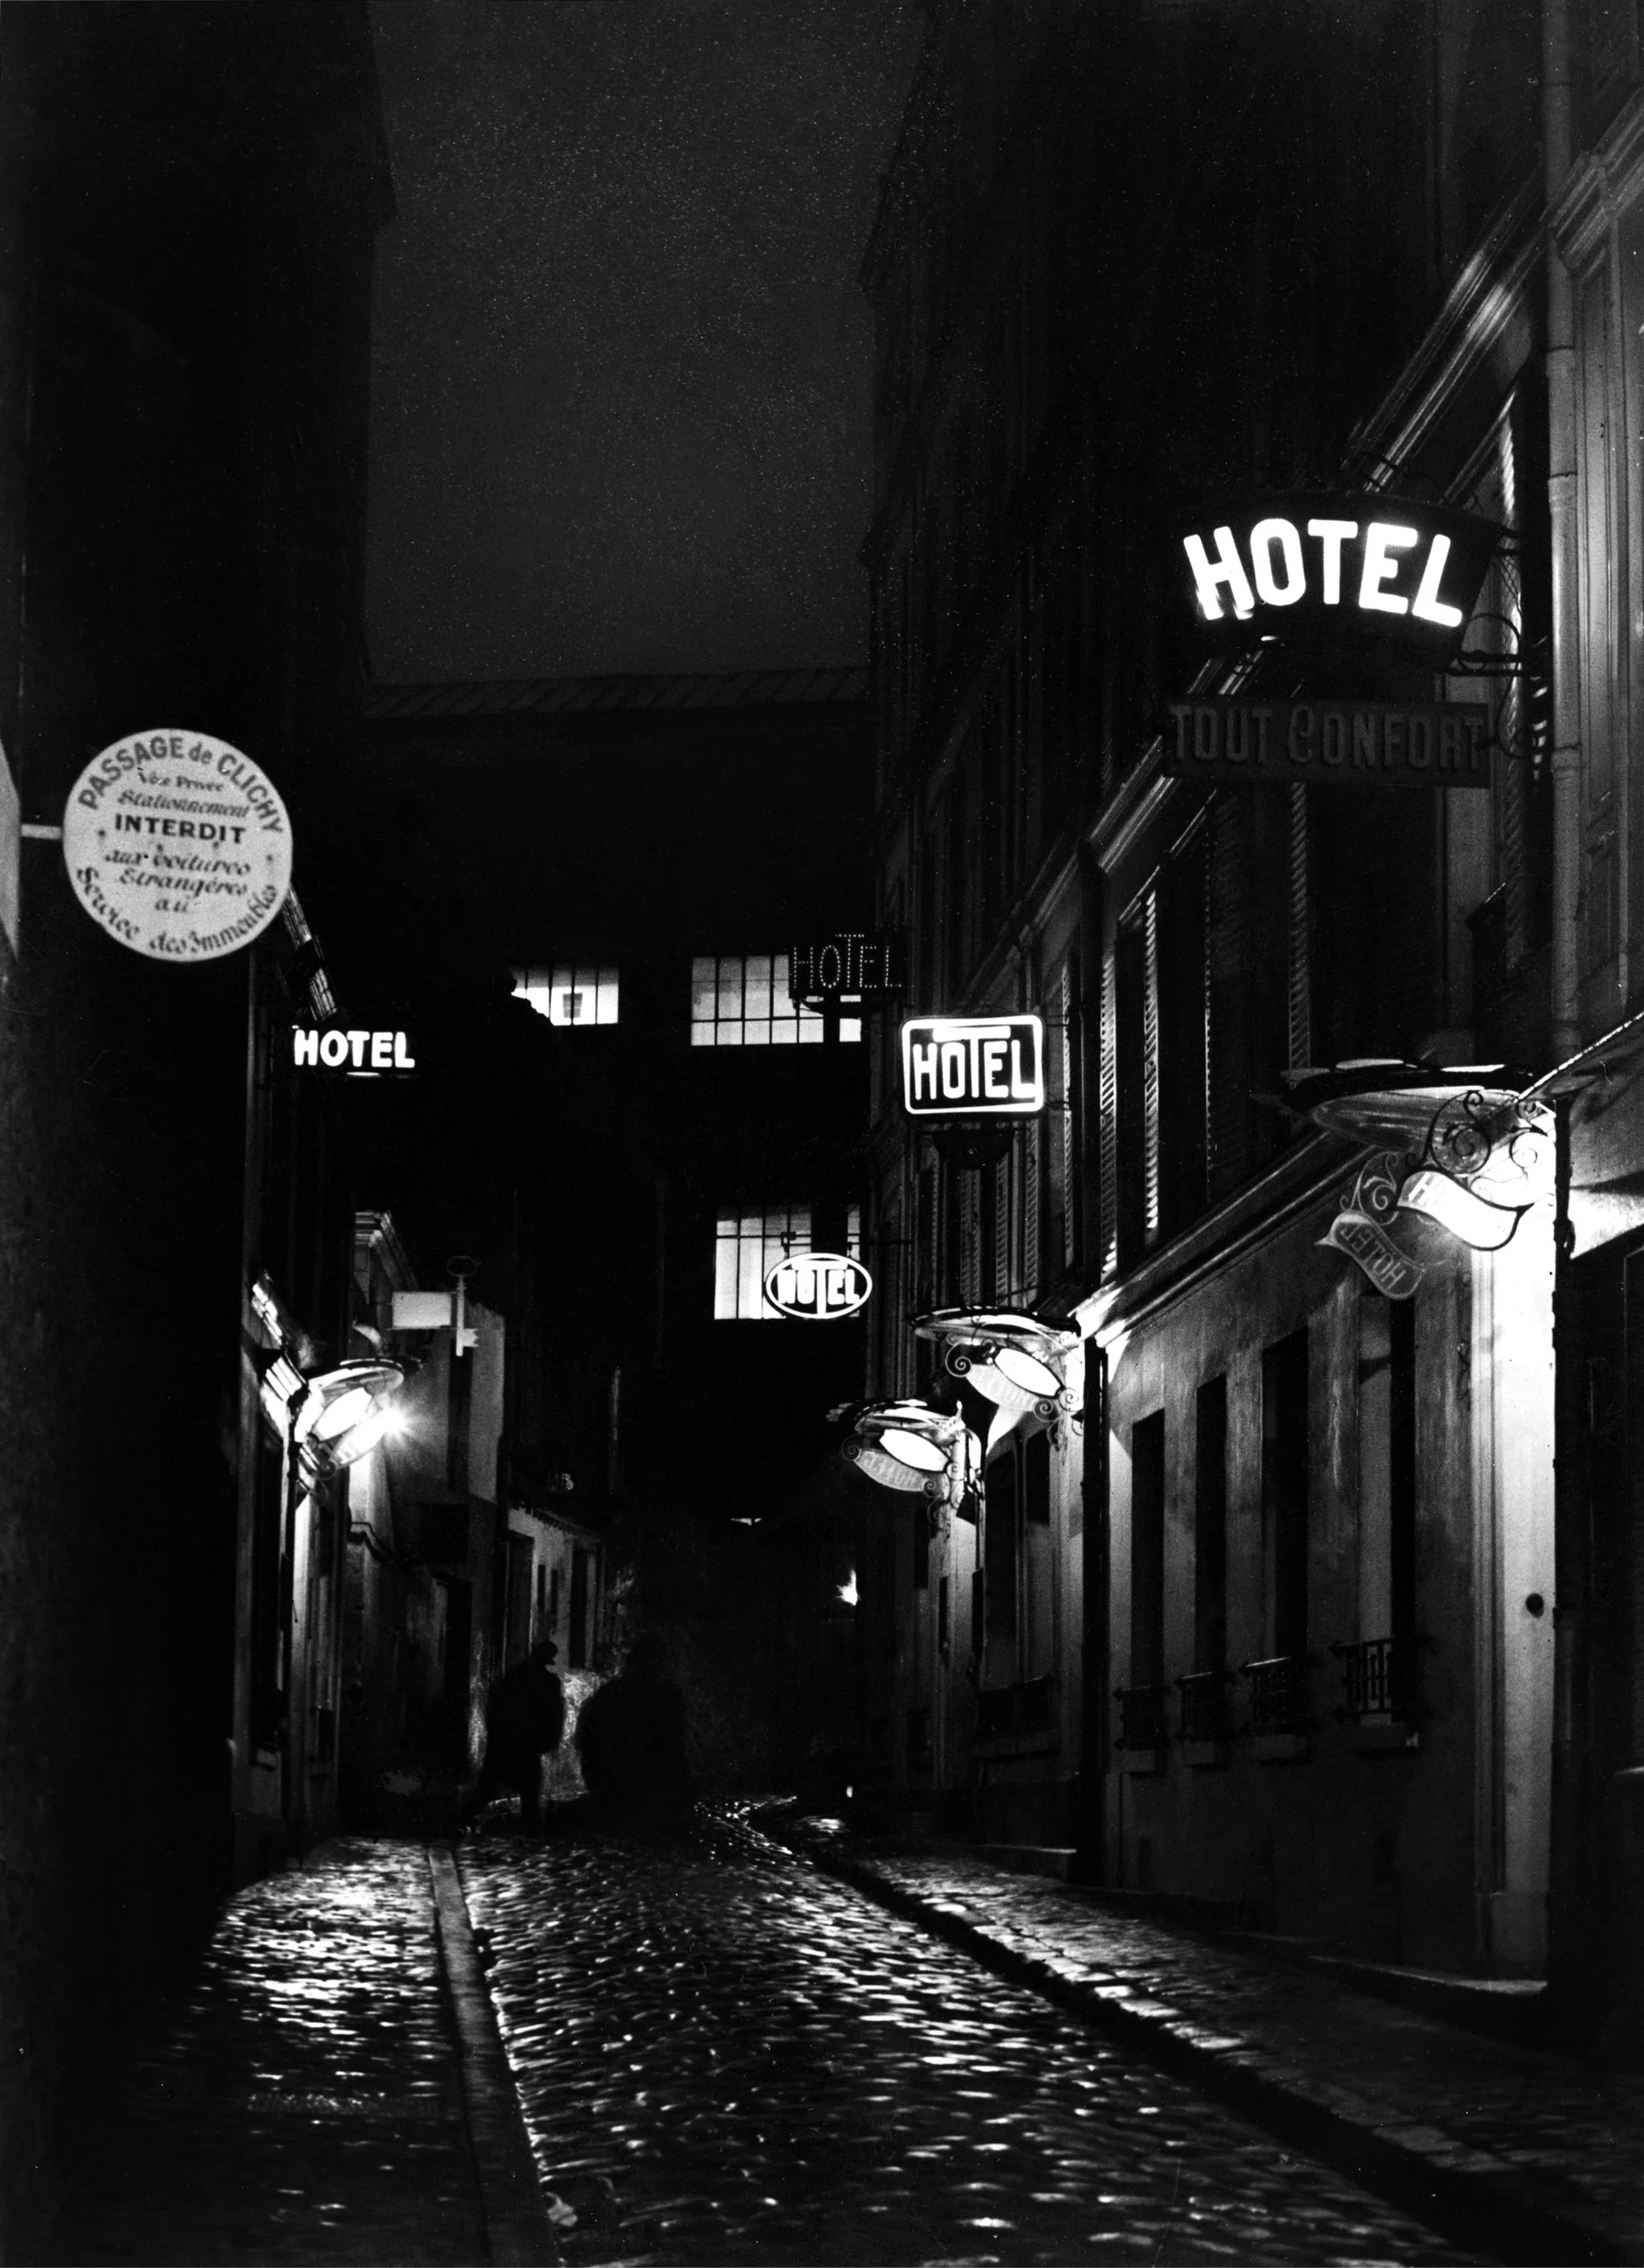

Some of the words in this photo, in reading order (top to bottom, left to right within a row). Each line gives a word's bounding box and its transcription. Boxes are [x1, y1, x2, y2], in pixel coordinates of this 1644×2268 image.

[1183, 518, 1463, 628] HOTEL
[1169, 705, 1273, 764] TOUT
[1288, 703, 1485, 770] CONFORT
[79, 736, 185, 810] PASSAGE
[188, 741, 214, 765] de
[216, 753, 283, 834] CLICHY
[115, 813, 246, 844] INTERDIT
[791, 933, 903, 990] HOTEL
[294, 1029, 417, 1069] HOTEL
[912, 1025, 1037, 1101] HOTEL
[776, 1260, 861, 1315] HOTEL
